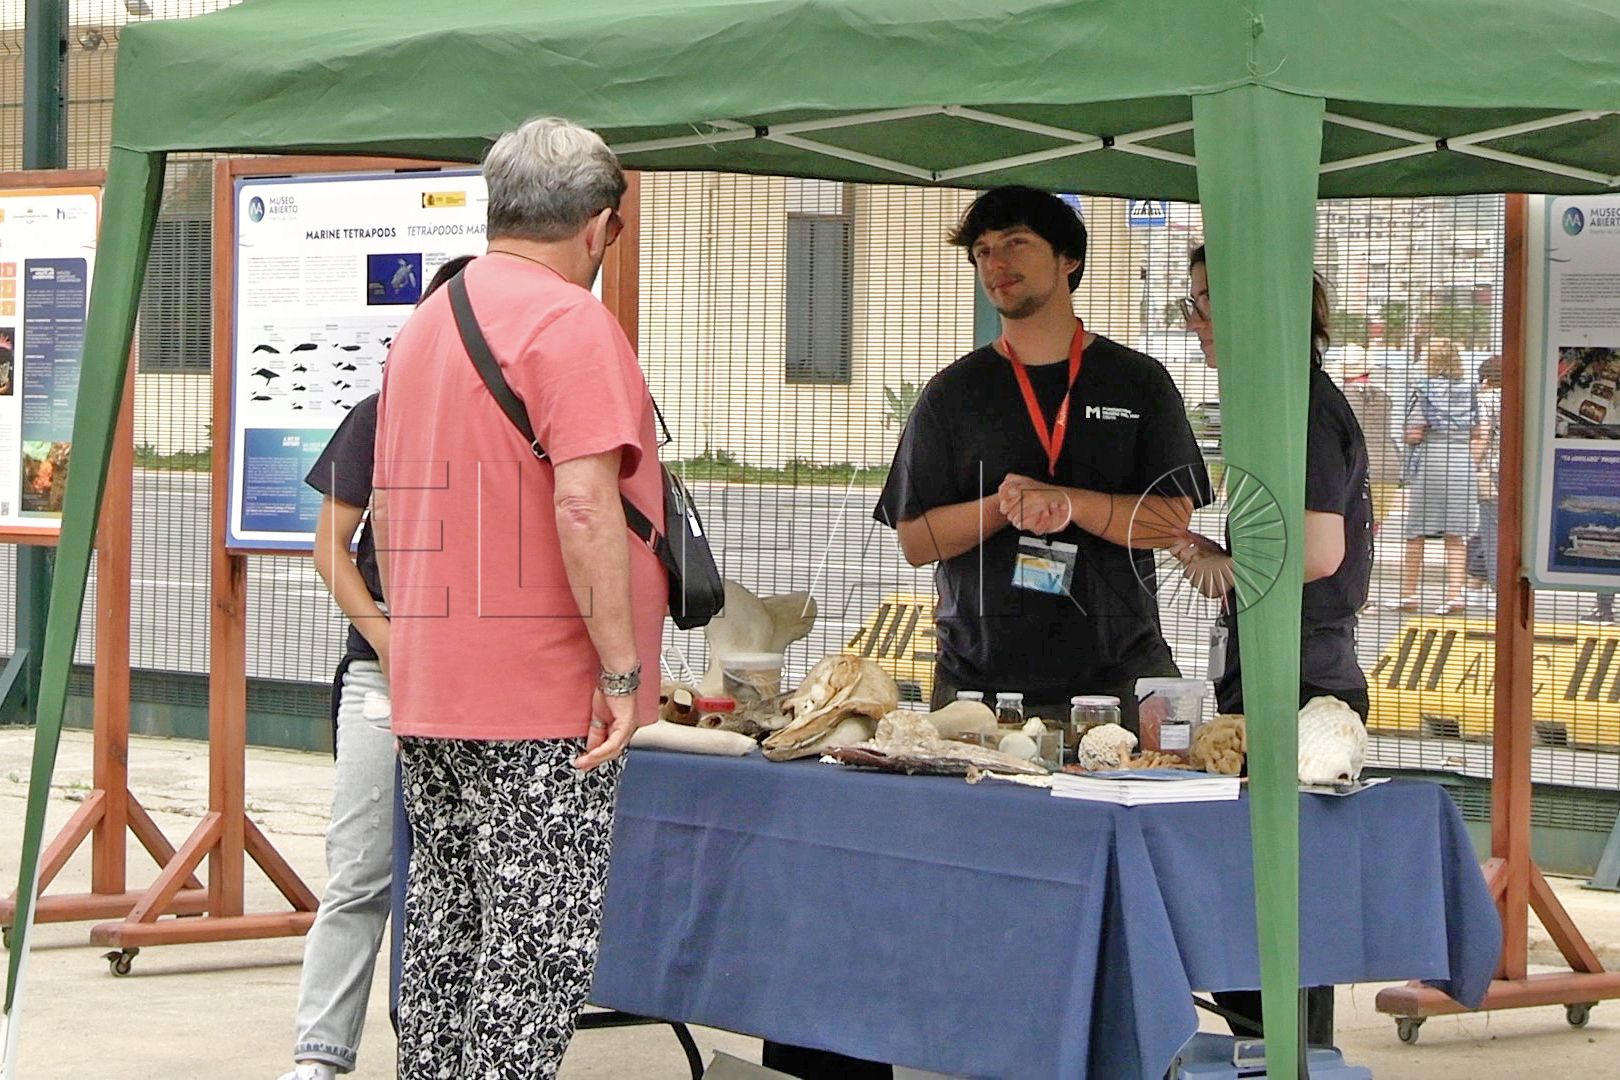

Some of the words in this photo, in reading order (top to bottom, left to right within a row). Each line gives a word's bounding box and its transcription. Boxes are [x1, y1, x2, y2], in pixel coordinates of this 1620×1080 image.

[269, 196, 295, 206] MUSEO
[269, 205, 298, 215] ABIERTO
[1590, 217, 1620, 227] ABIERT
[305, 228, 340, 240] MARINE
[343, 227, 397, 239] TETRAPODS
[407, 221, 464, 237] TETRÁPODOS
[466, 223, 487, 235] MAR
[1085, 405, 1101, 419] M
